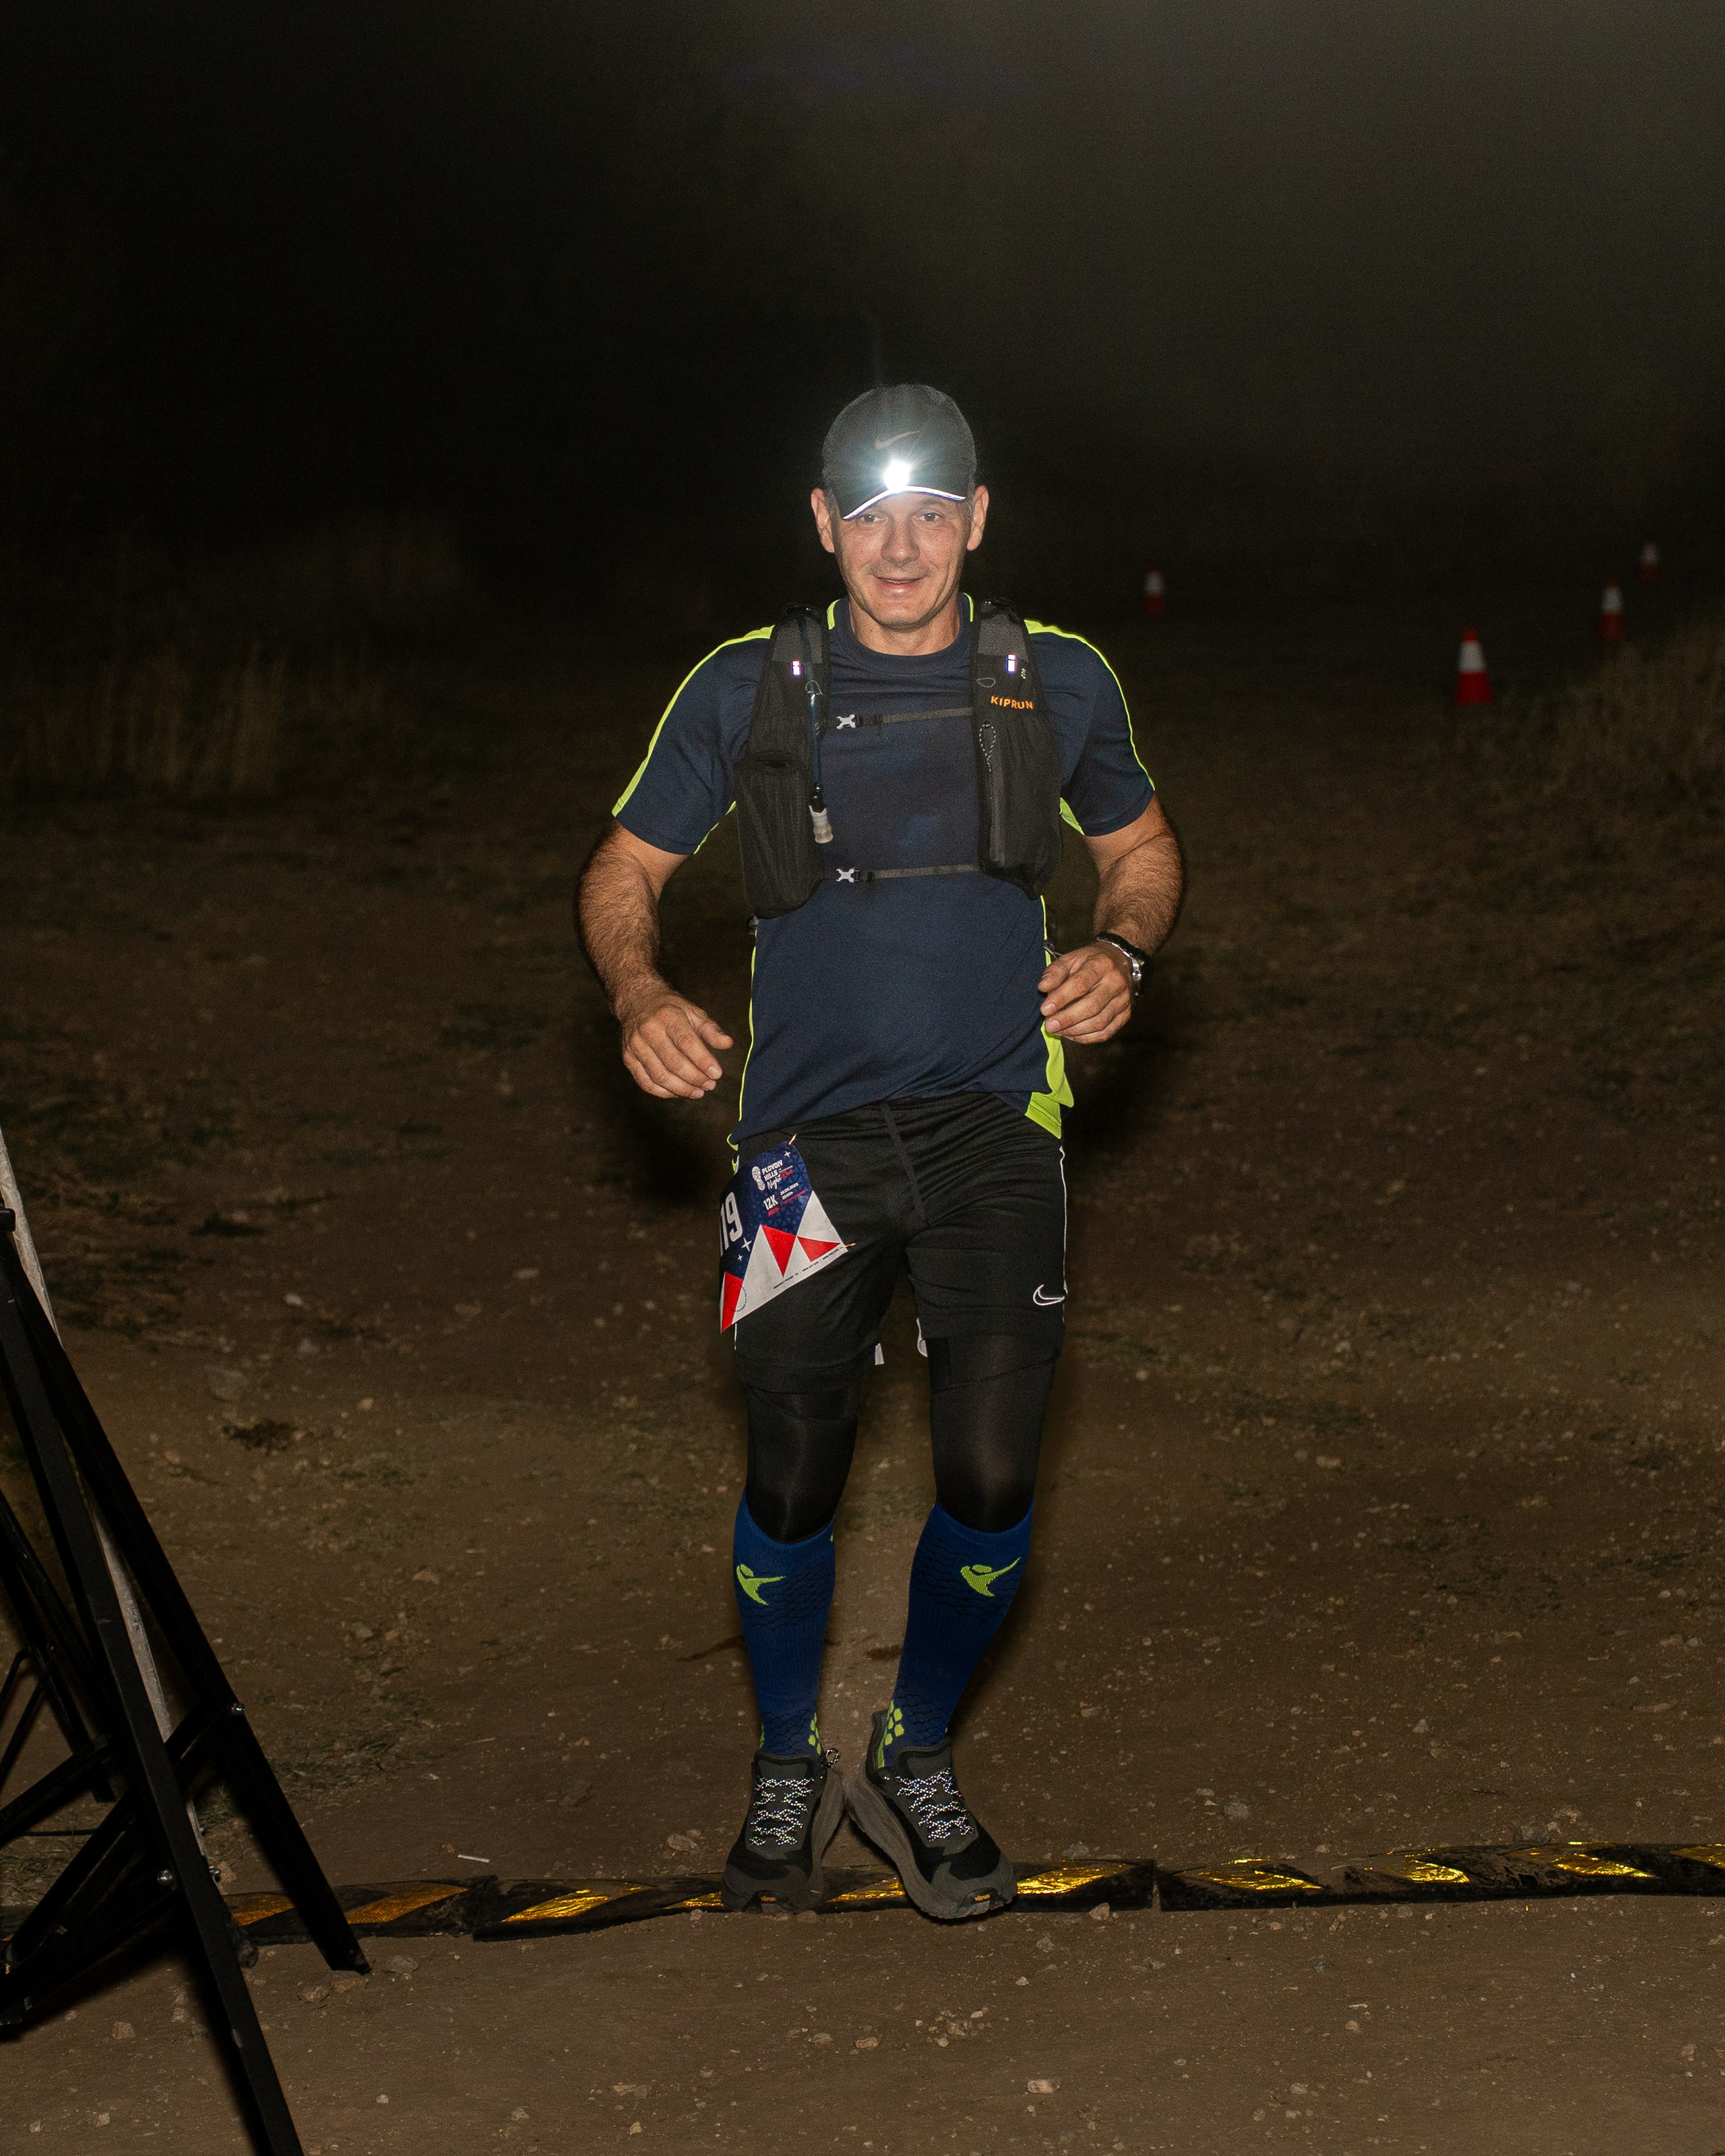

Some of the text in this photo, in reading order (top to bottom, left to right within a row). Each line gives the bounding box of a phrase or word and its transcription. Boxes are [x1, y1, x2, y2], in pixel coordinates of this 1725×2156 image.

[991, 695, 1033, 709] KIPRUN
[761, 1160, 783, 1175] PLOVDIV
[763, 1170, 778, 1181] HILLS
[763, 1195, 778, 1210] 12K
[720, 1192, 743, 1257] 19
